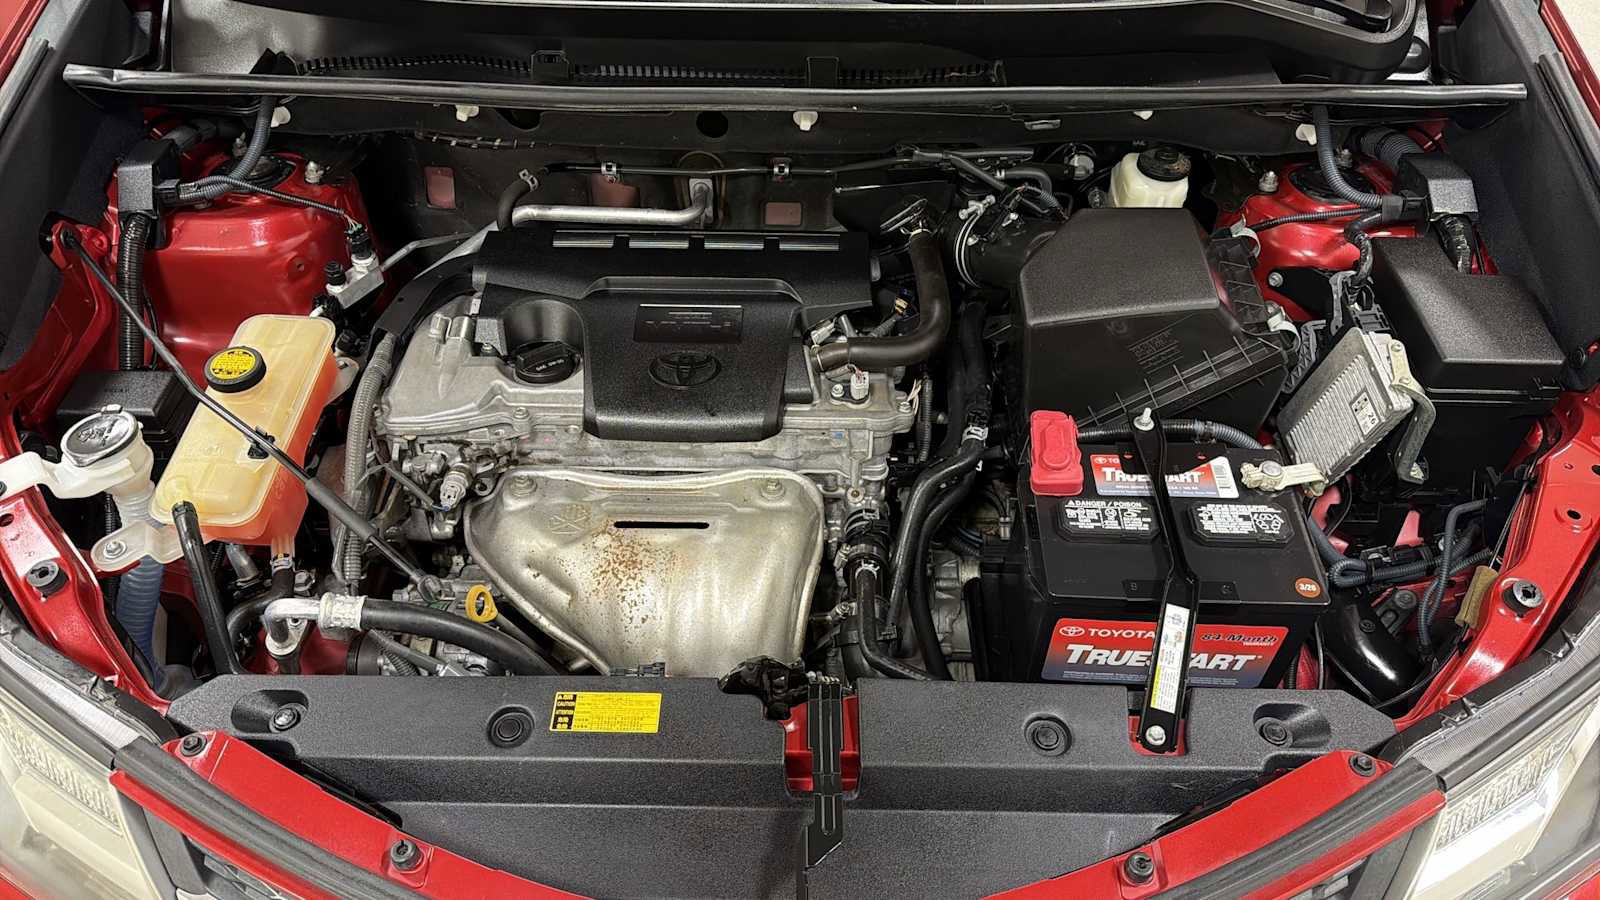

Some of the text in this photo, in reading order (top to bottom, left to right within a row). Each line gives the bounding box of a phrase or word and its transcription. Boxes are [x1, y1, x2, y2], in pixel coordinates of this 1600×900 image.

[1101, 467, 1202, 483] TRUEART
[1088, 628, 1156, 639] TOYOTA
[1225, 633, 1278, 642] Month
[1066, 643, 1257, 671] TRUEART
